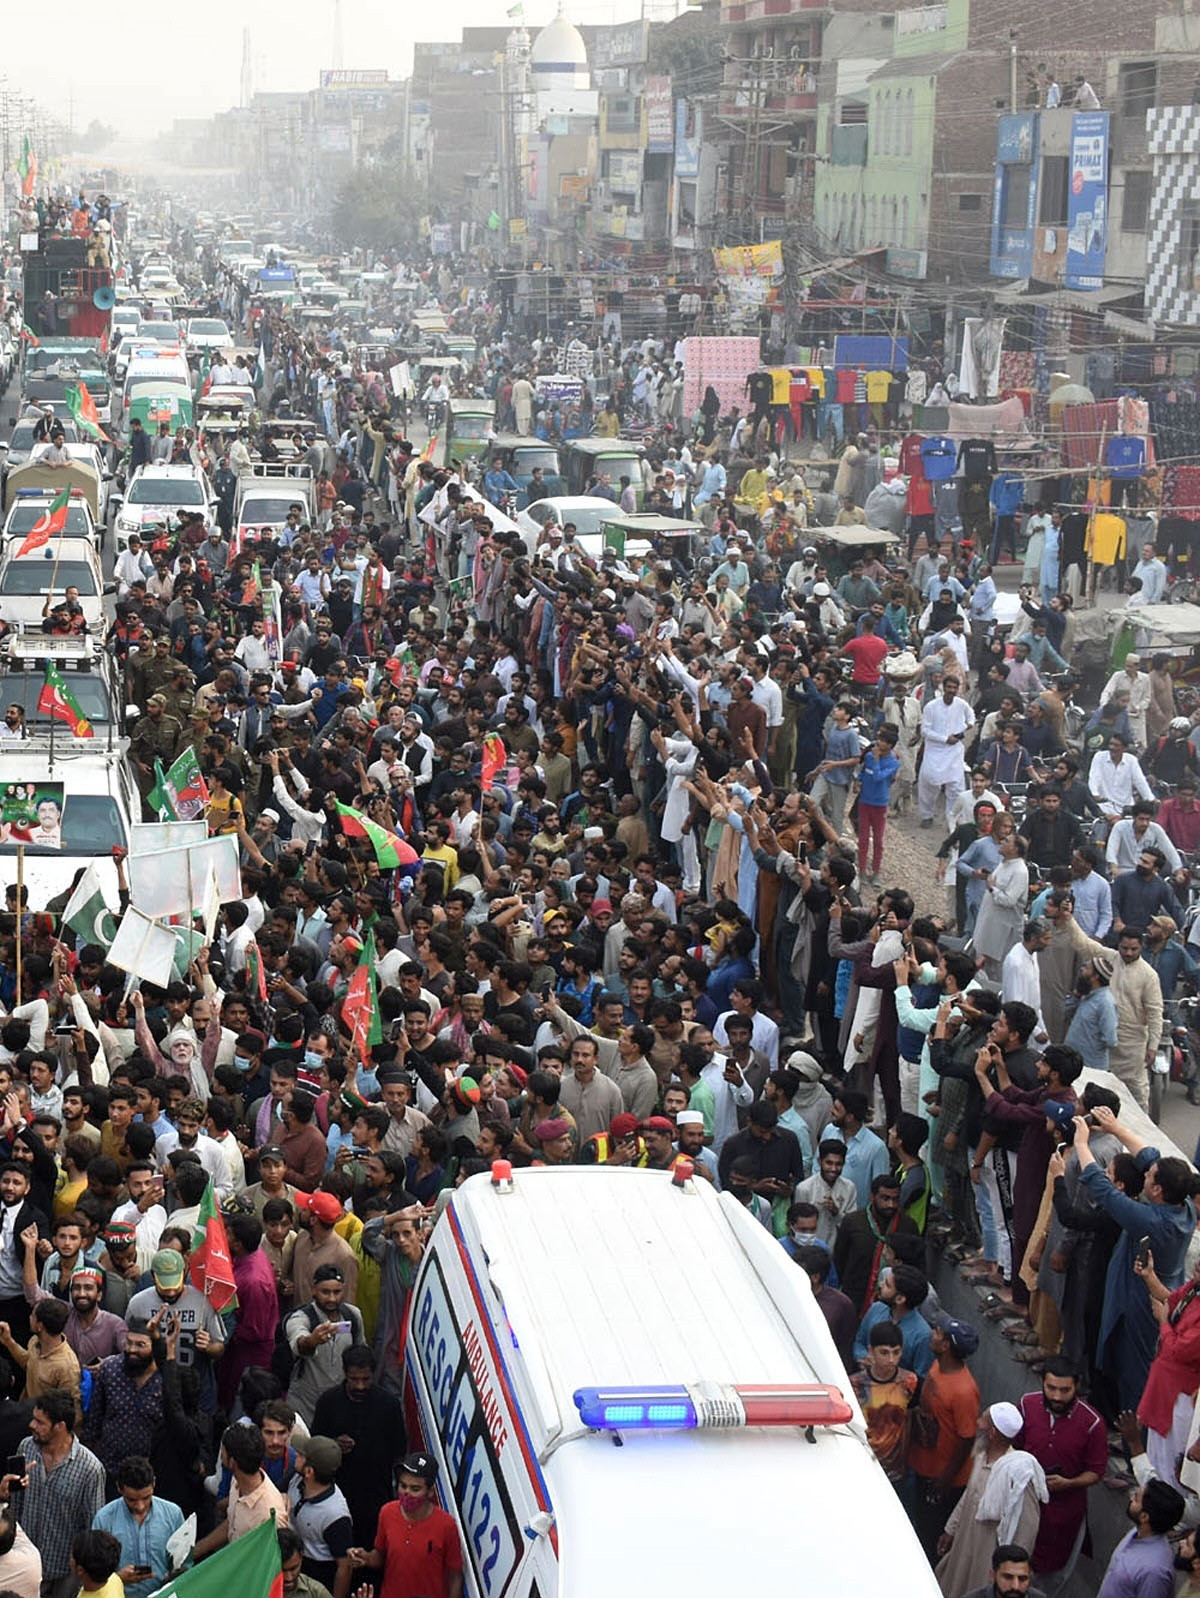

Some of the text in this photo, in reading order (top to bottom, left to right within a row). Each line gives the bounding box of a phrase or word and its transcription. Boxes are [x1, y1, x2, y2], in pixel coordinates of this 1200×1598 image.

[151, 1309, 196, 1323] PAER
[418, 1286, 468, 1475] RESCUE
[462, 1320, 508, 1459] AMBULANCE
[462, 1444, 501, 1597] 1122
